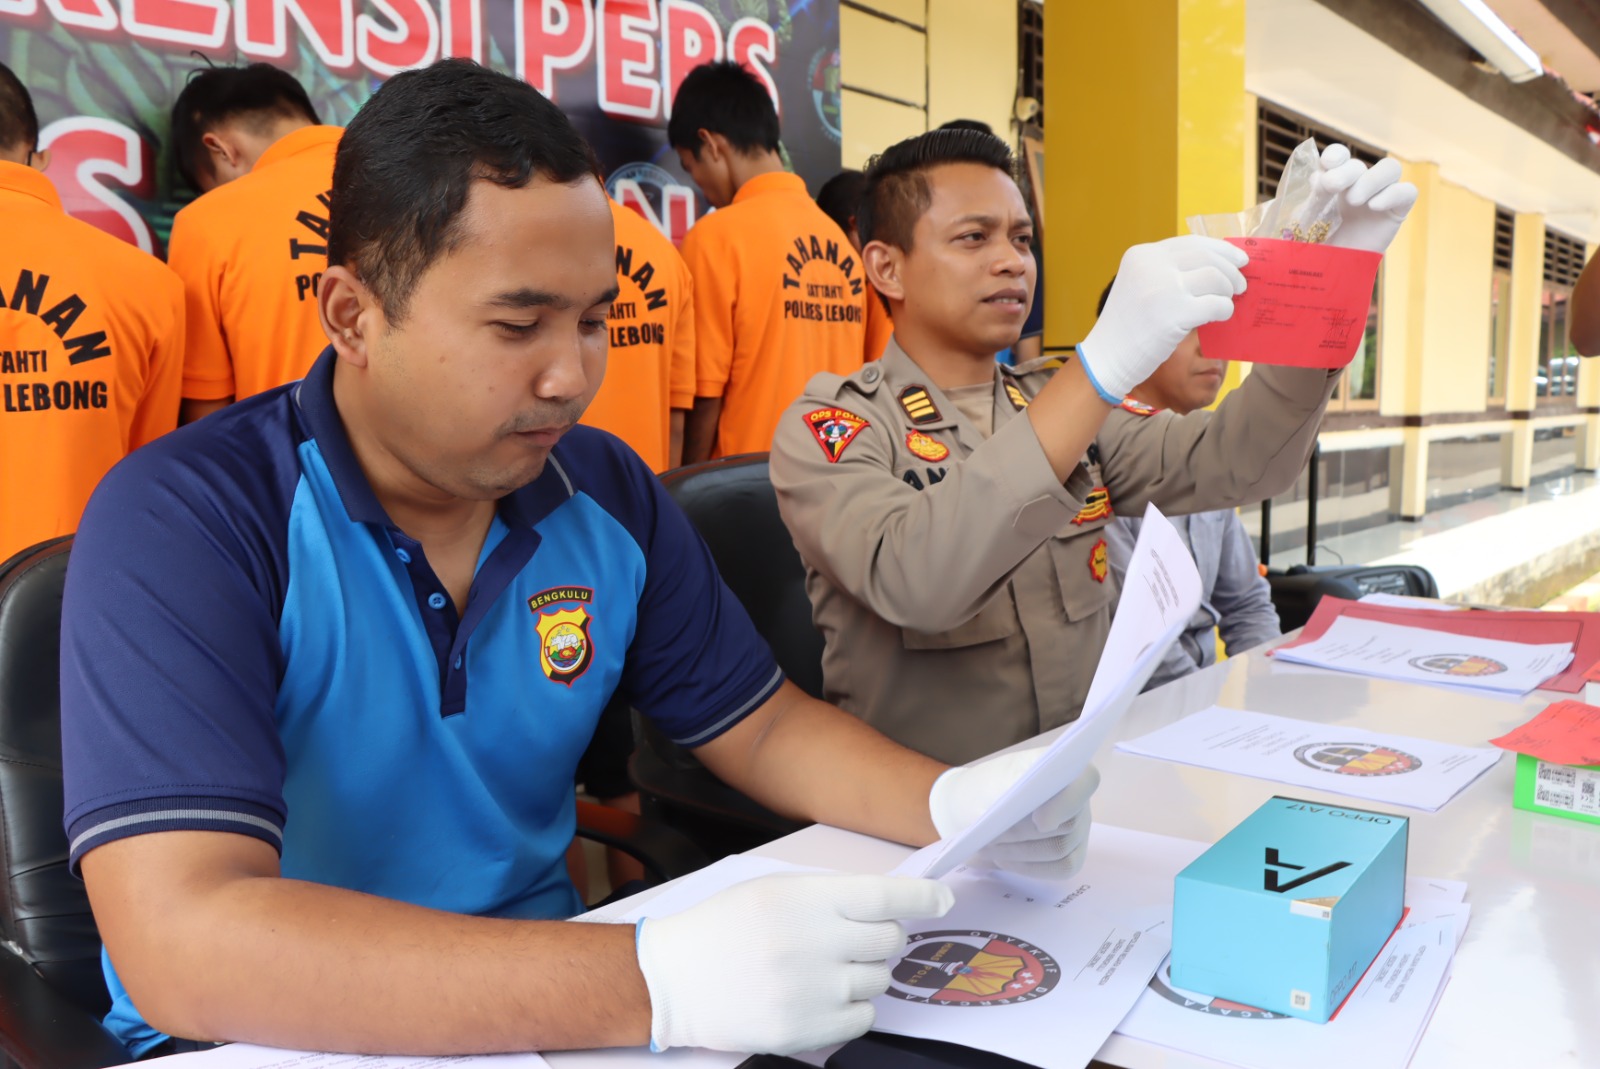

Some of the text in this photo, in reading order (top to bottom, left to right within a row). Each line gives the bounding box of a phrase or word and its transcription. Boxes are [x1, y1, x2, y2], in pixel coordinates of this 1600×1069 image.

[783, 234, 863, 296] TAHANAN
[607, 302, 637, 319] AHTI
[610, 322, 665, 348] LEBONG
[3, 380, 108, 412] LEBONG
[811, 410, 832, 421] OPS
[530, 590, 589, 609] BENGKULU
[1286, 803, 1392, 825] OPPO A17
[969, 931, 1058, 974] OBYEKTIF
[905, 985, 1049, 1007] DIPERCAYA
[1183, 999, 1276, 1018] RCAYA
